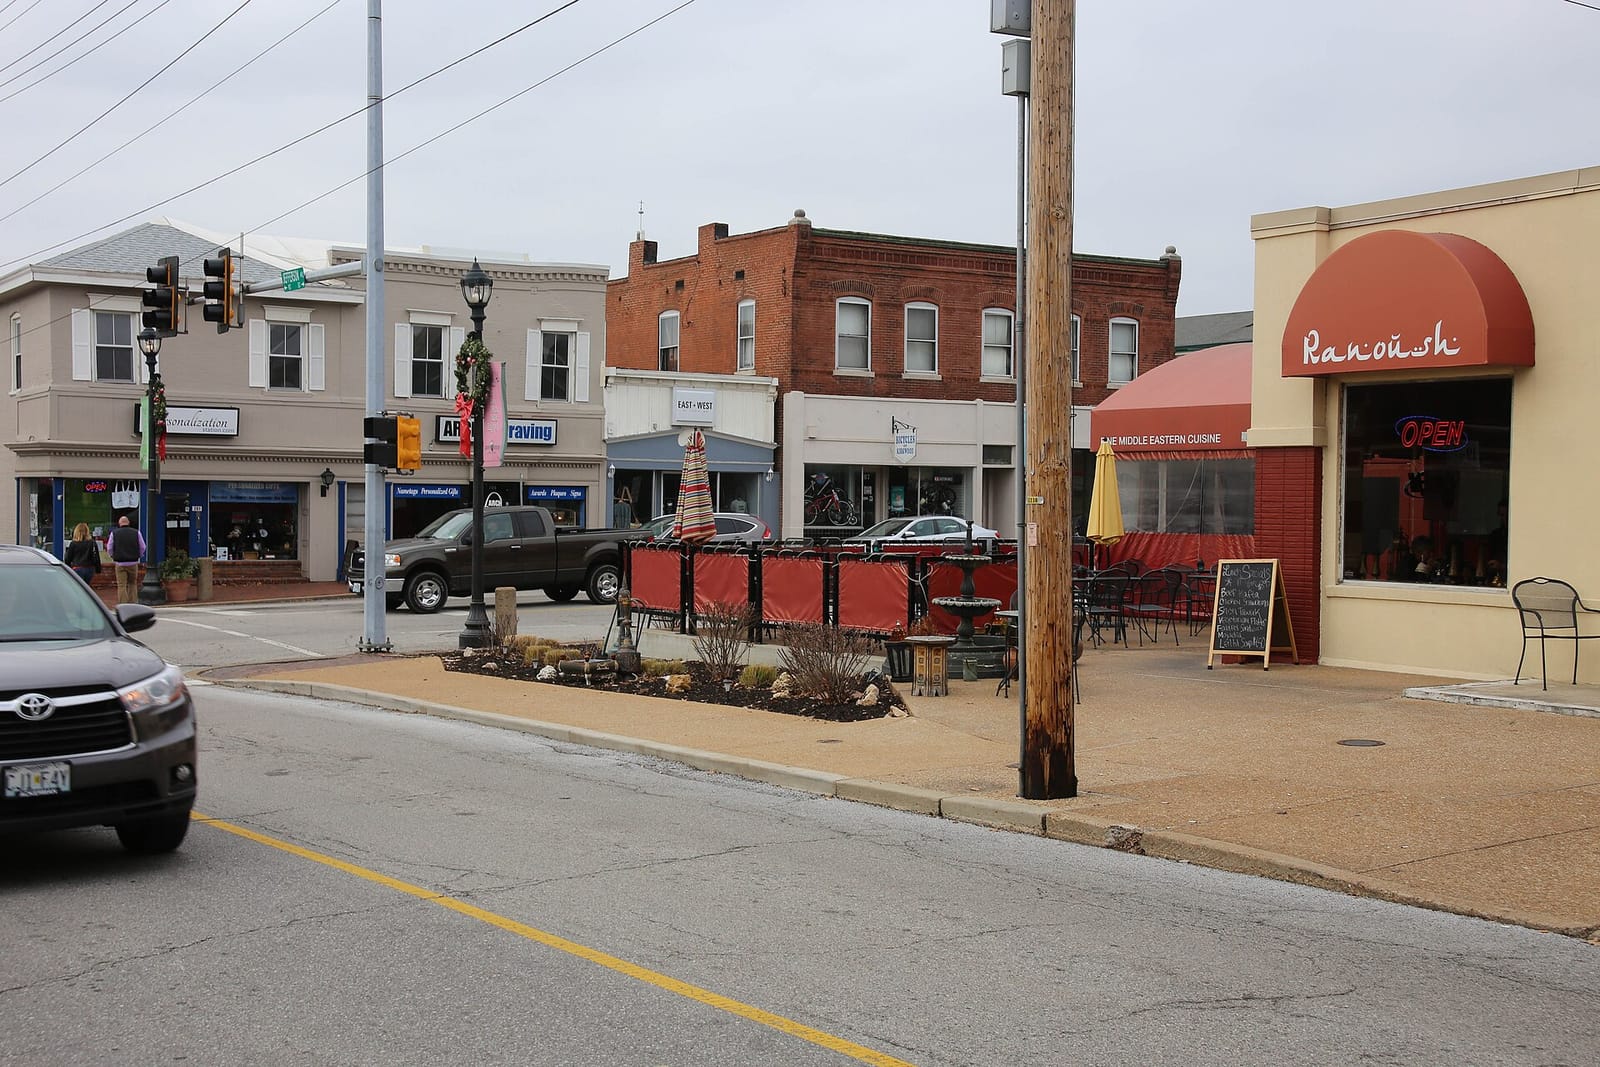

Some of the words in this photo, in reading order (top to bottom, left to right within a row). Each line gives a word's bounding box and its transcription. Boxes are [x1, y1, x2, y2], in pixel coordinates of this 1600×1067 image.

[677, 400, 692, 409] EAST
[696, 401, 713, 410] WEST
[508, 423, 553, 441] raving
[1401, 420, 1464, 448] OPEN
[1100, 436, 1118, 446] FNE
[1118, 435, 1148, 445] MIDDLE
[1149, 434, 1186, 445] EASTERN
[1187, 433, 1222, 444] CUISINE
[85, 483, 107, 491] OPEN
